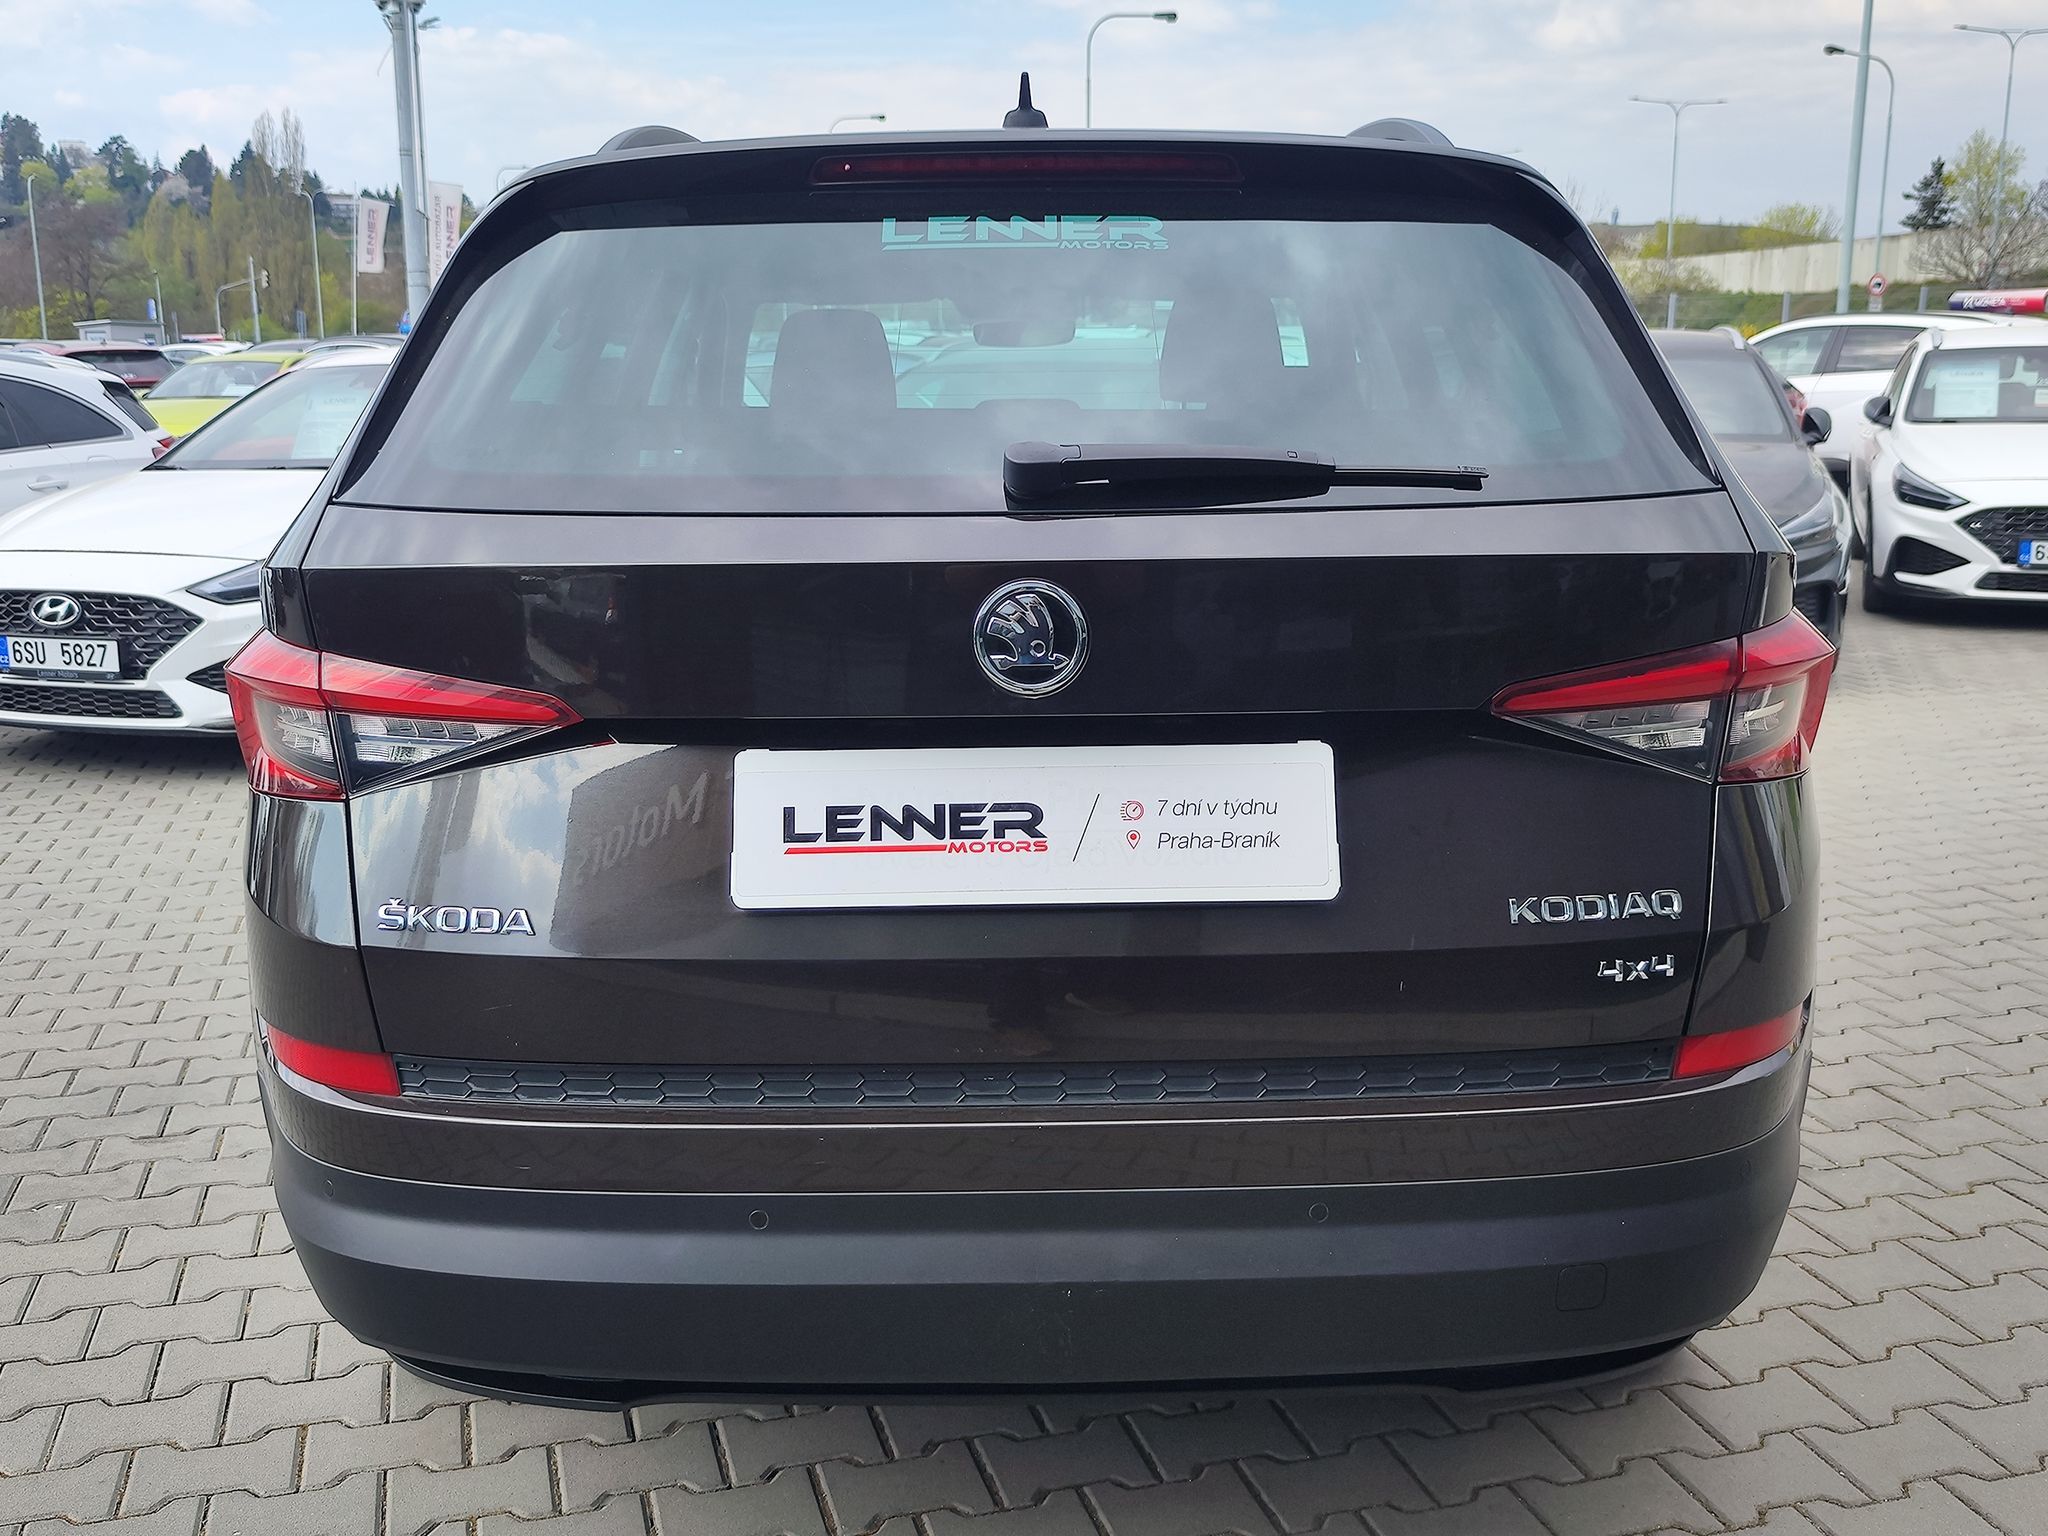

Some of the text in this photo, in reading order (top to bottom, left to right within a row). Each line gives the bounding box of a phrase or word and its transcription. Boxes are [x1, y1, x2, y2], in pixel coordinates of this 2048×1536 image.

[882, 215, 1169, 243] LENNER
[1059, 239, 1169, 250] MOTORS
[12, 640, 108, 668] 6SU 5827
[783, 802, 1048, 843] LENNER
[1157, 799, 1279, 820] 7 dní v týdnu
[947, 840, 1049, 854] MOTORS
[1157, 831, 1281, 850] Praha-Braník
[377, 897, 537, 937] ŠKODA
[1508, 889, 1684, 925] KODIAQ
[1597, 954, 1676, 982] 4x4
